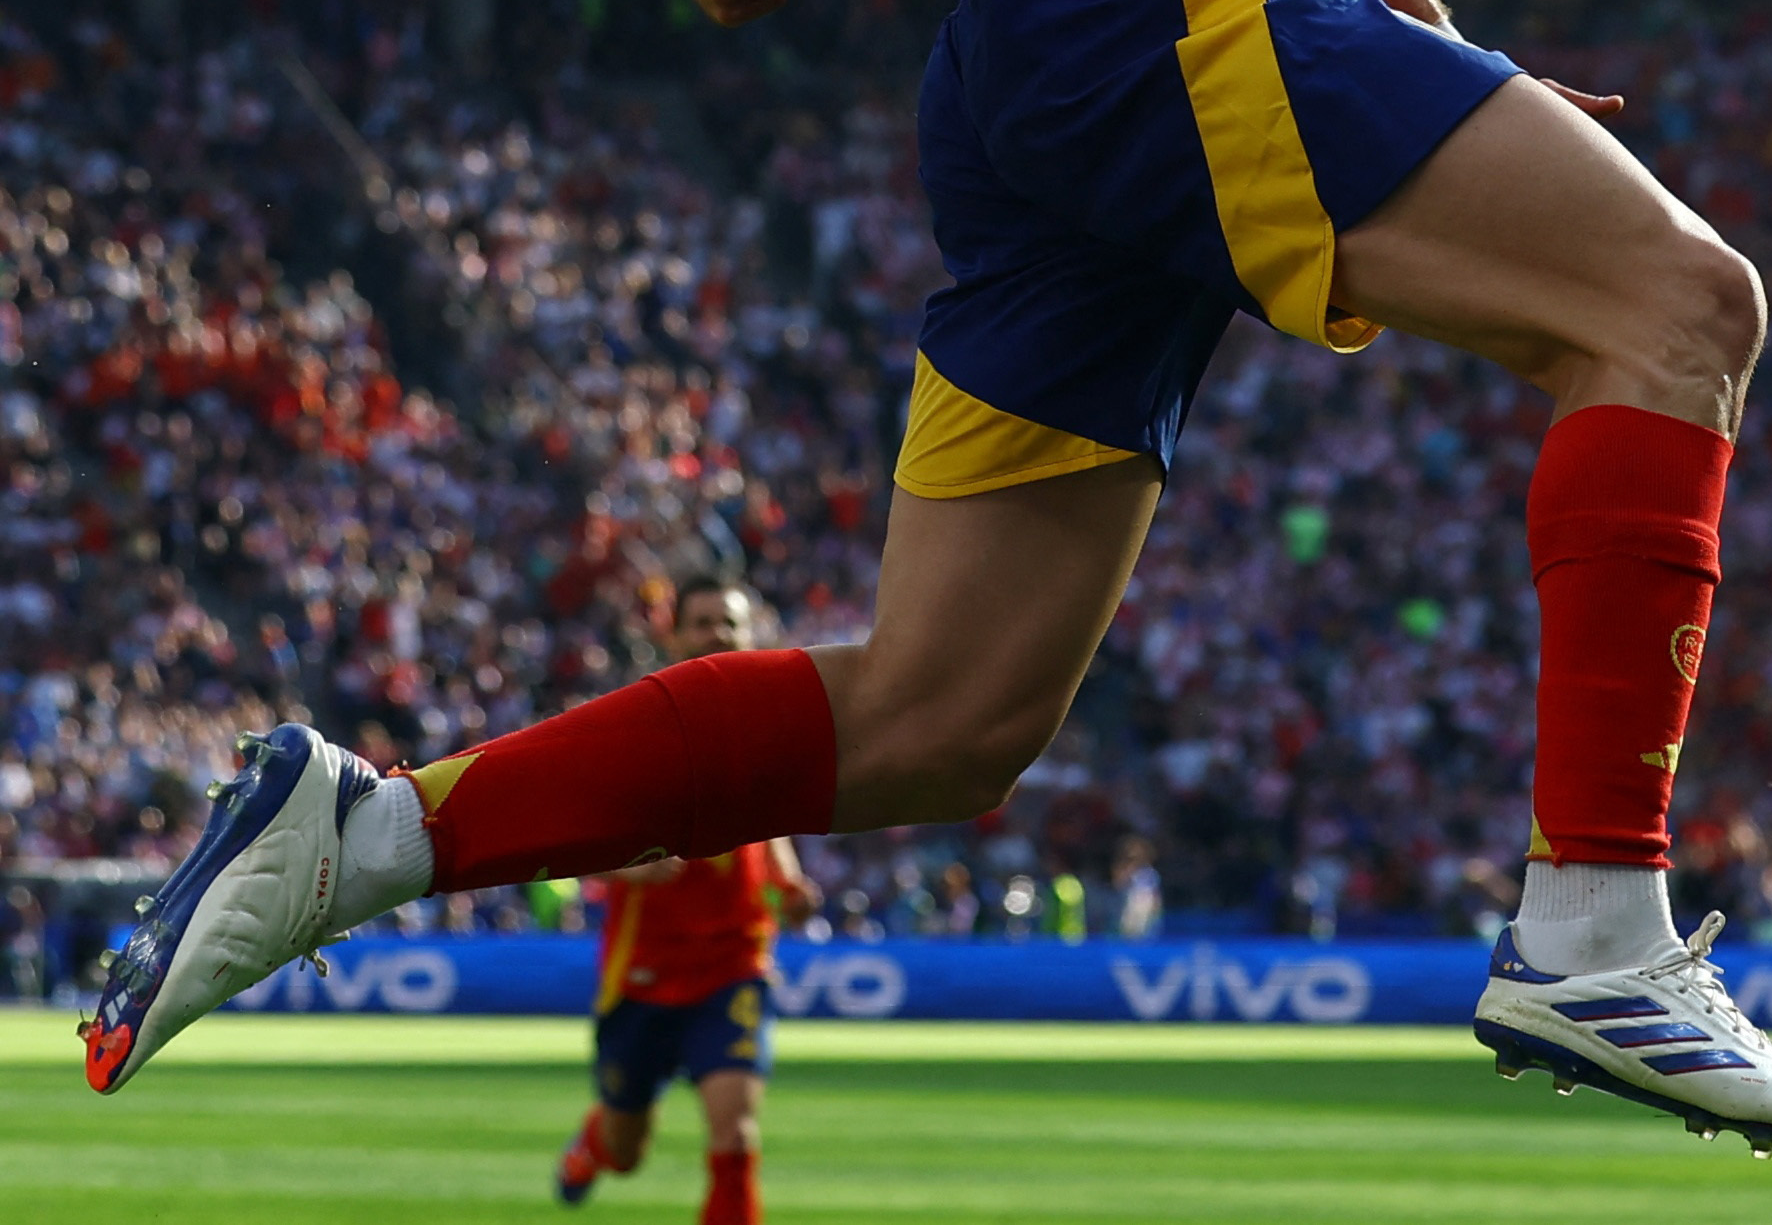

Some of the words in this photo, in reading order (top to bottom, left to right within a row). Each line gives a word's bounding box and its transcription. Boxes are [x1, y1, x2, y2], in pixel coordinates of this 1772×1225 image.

[316, 857, 330, 900] COPA
[766, 953, 906, 1015] vo
[1110, 941, 1371, 1023] vivo
